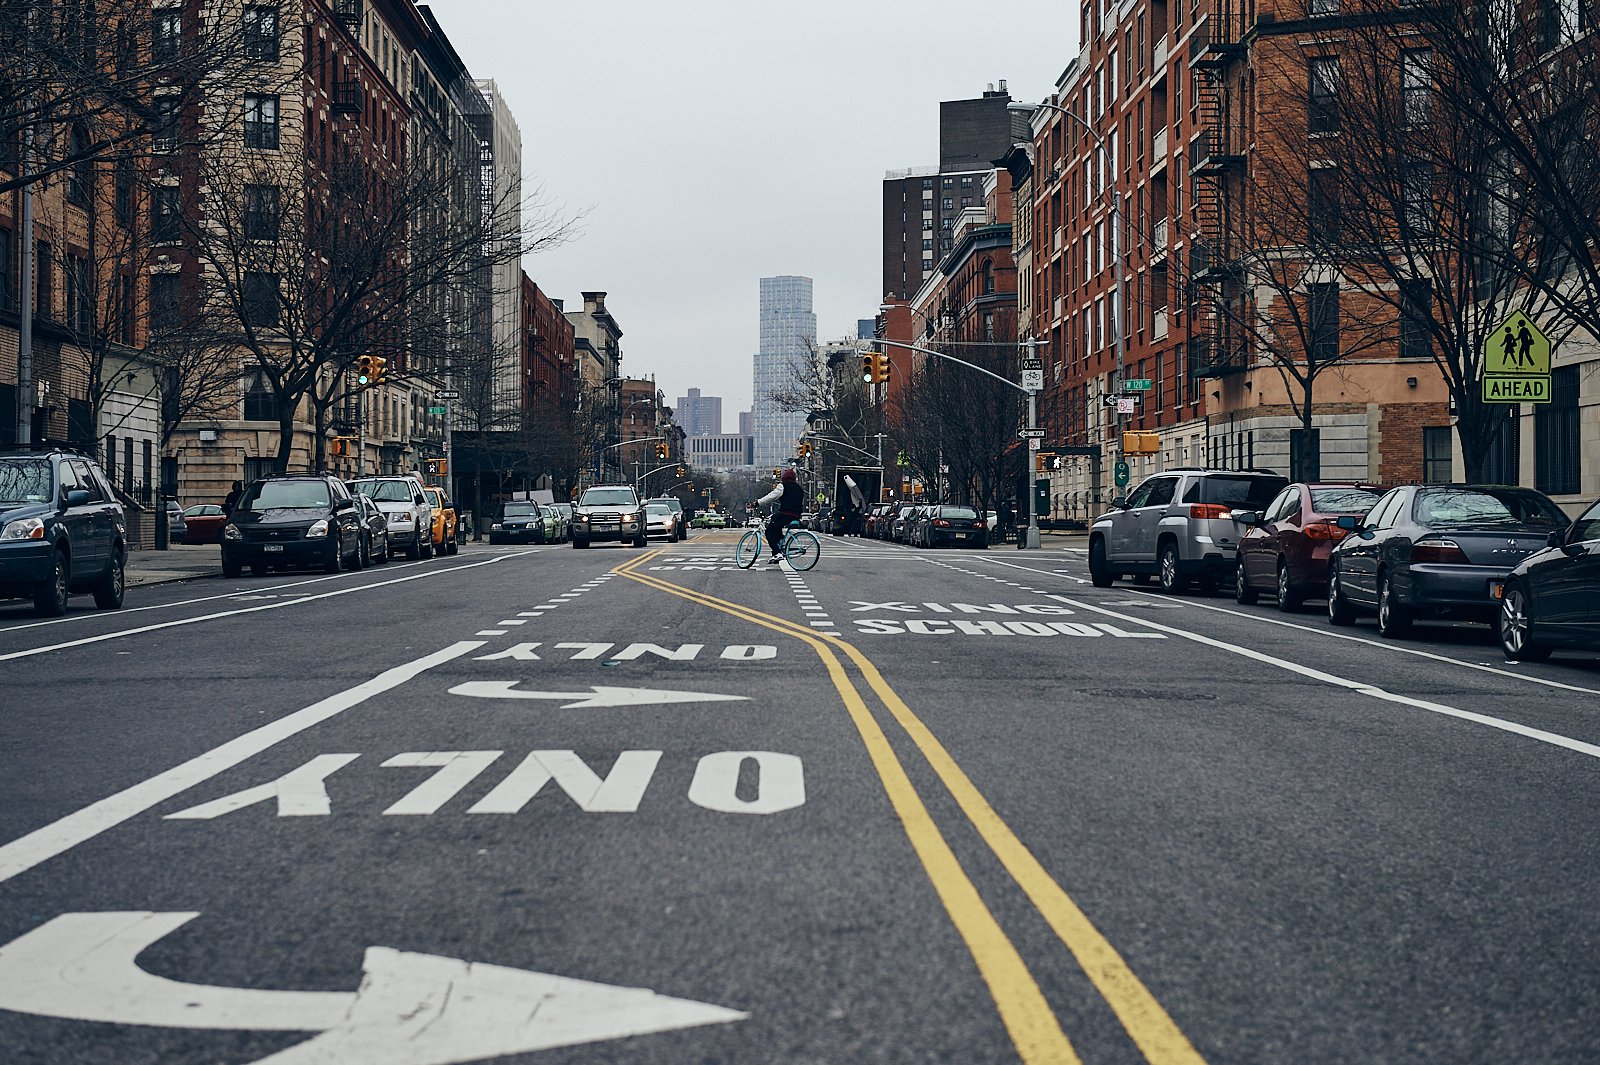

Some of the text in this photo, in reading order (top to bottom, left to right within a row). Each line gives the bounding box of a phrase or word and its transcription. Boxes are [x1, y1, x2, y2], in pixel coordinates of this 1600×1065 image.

[1126, 381, 1132, 389] W
[1133, 380, 1143, 389] 120
[1490, 381, 1544, 397] AHEAD
[852, 619, 1169, 639] SCHOOL
[472, 642, 778, 660] ONLY
[162, 750, 806, 819] ONLY
